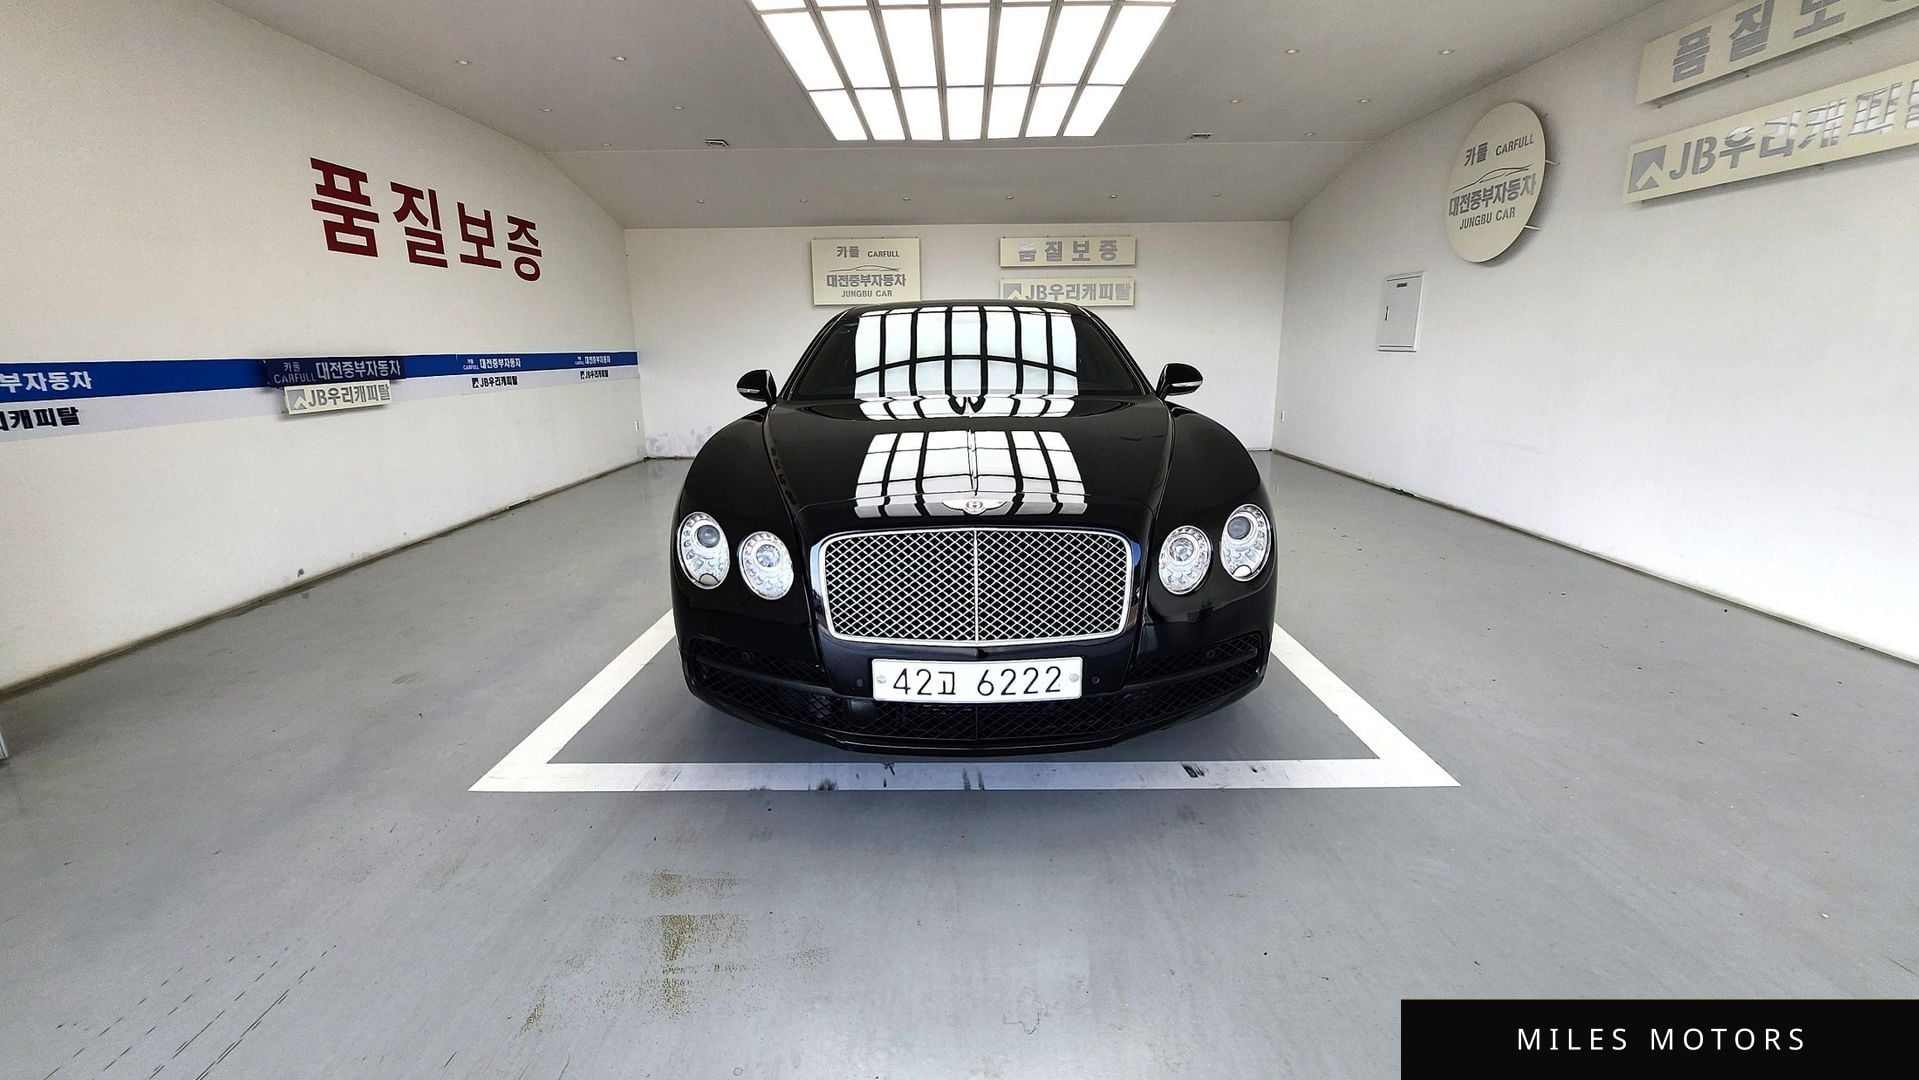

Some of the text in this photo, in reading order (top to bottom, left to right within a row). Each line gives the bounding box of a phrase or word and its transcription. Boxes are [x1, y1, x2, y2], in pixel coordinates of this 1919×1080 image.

[1669, 79, 1919, 180] JB우리캐피
[1495, 133, 1534, 156] CARFULL
[1448, 173, 1537, 217] 대전중부자동차
[309, 157, 543, 282] 품질보증
[1459, 206, 1516, 230] JUNGBU CAR
[867, 250, 900, 258] CARFULL
[1018, 240, 1118, 262] 품질보증
[826, 274, 906, 287] 대전중부자동차
[841, 290, 873, 298] JUNGBU
[1025, 283, 1132, 301] JB우리캐피탈
[273, 372, 317, 384] CARFULL
[315, 360, 401, 380] 대전중부자동차
[308, 383, 391, 407] JB우리캐피탈
[893, 666, 1062, 696] 42고 6222
